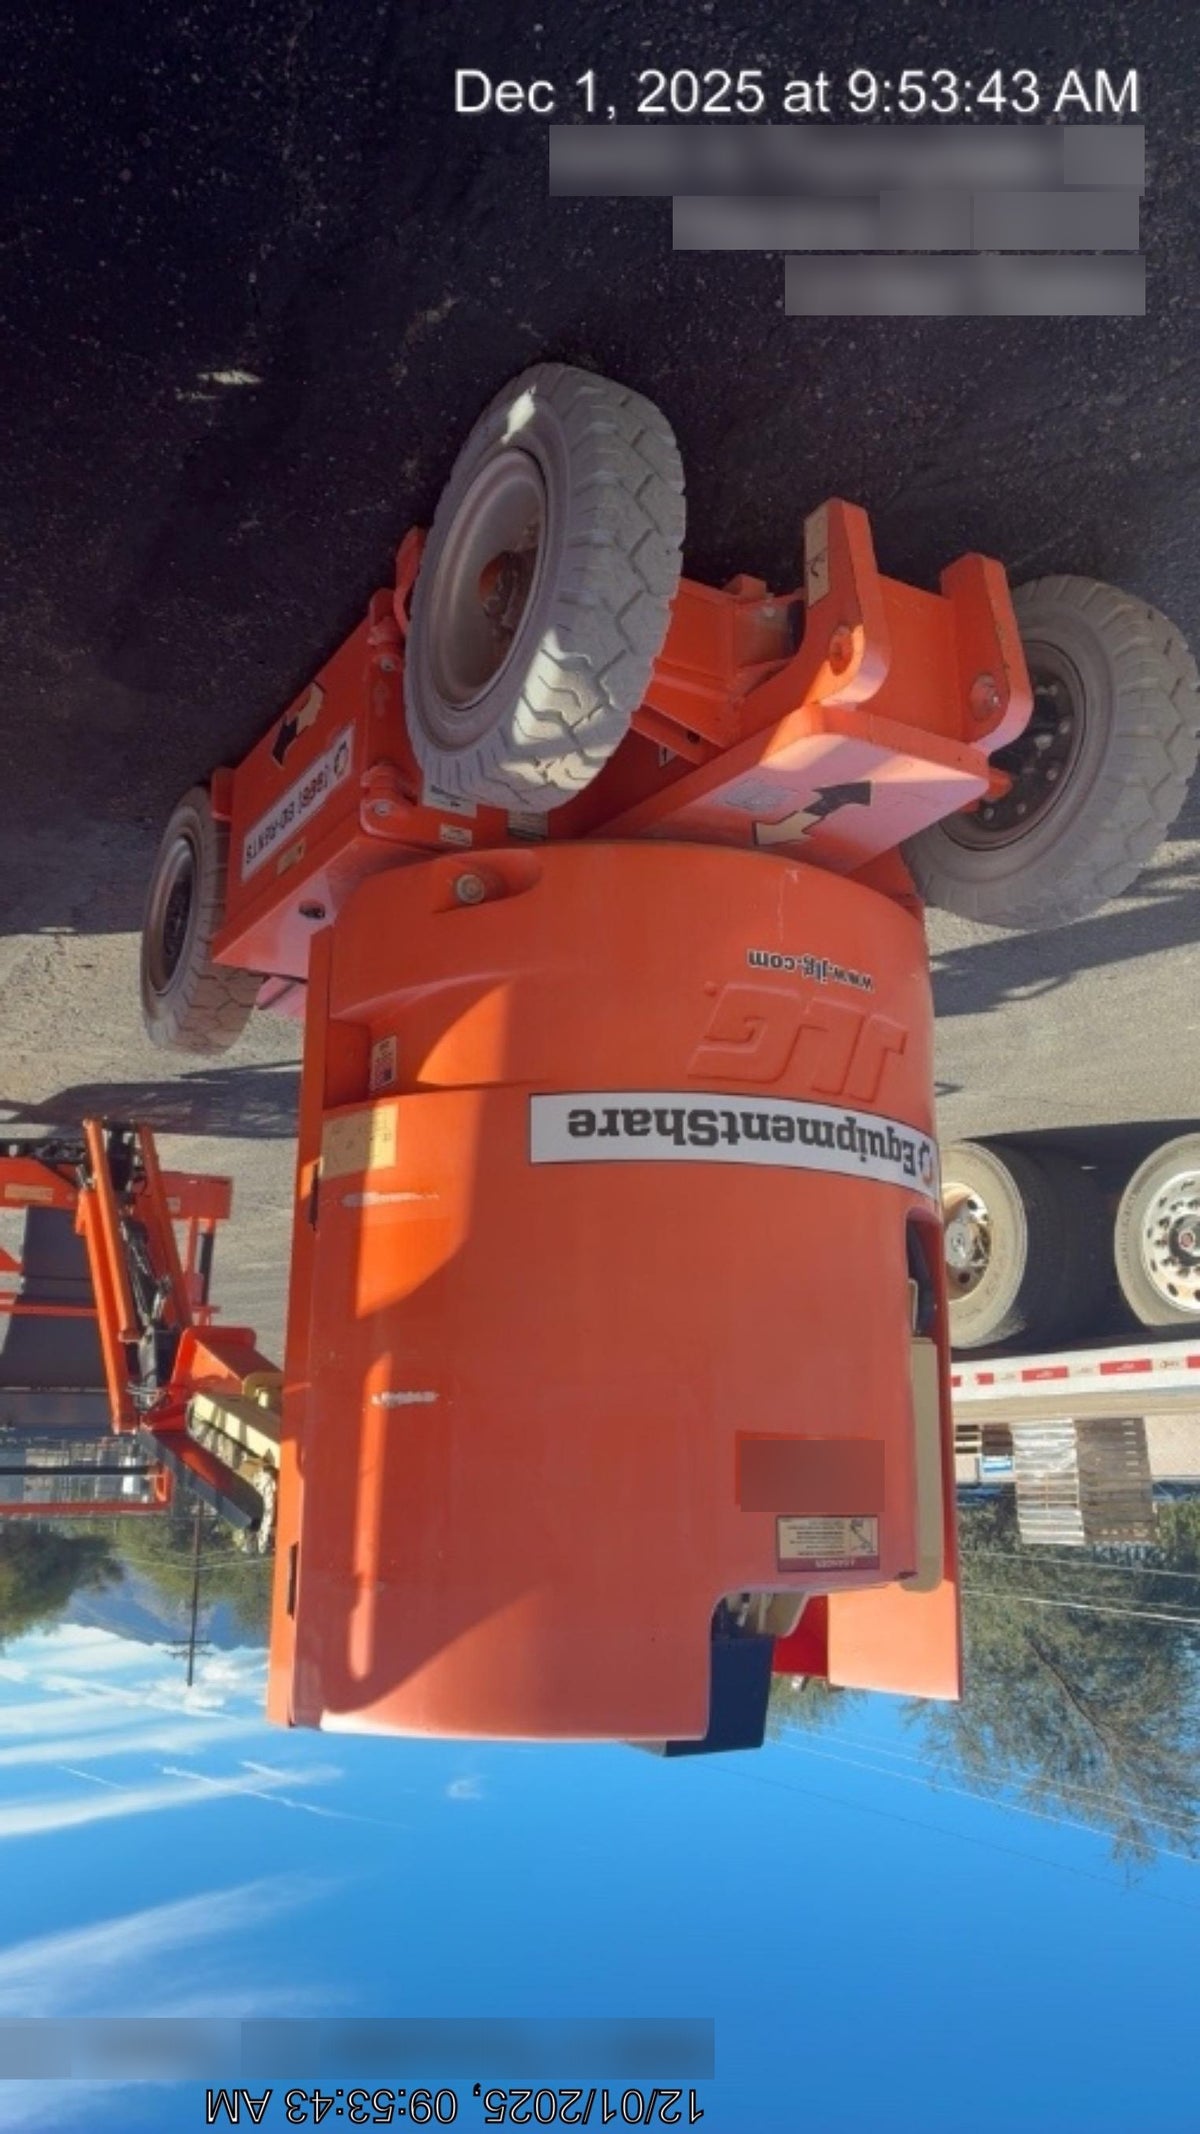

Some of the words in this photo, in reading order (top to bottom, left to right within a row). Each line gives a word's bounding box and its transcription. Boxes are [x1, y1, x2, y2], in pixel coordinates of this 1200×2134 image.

[748, 949, 874, 991] www.jlg.com
[687, 983, 909, 1104] JLG
[567, 1107, 918, 1176] EquipmentShare
